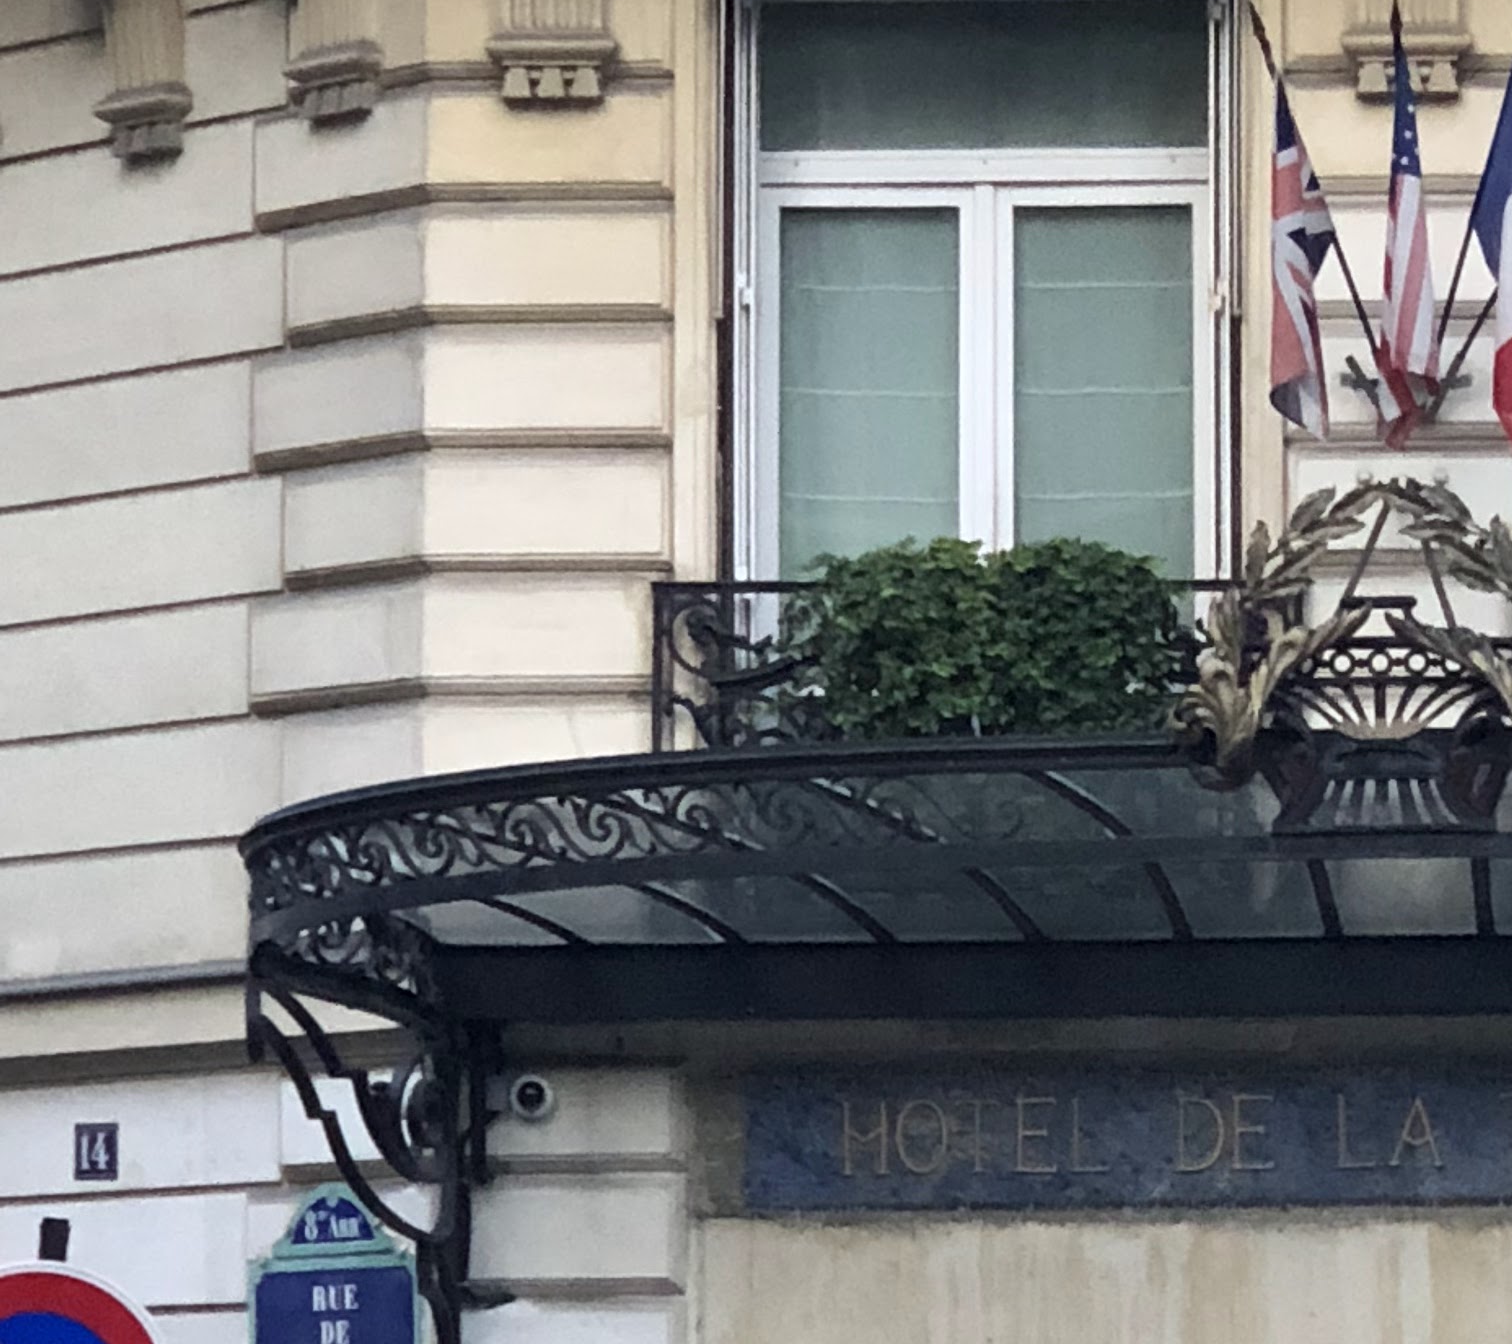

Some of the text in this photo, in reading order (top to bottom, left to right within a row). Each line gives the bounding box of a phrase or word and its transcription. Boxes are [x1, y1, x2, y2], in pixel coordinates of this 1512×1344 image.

[81, 1131, 110, 1170] 14
[841, 1093, 1111, 1176] HOTEL
[1173, 1092, 1277, 1173] DE
[1335, 1090, 1444, 1170] LA
[311, 1283, 360, 1312] RUE
